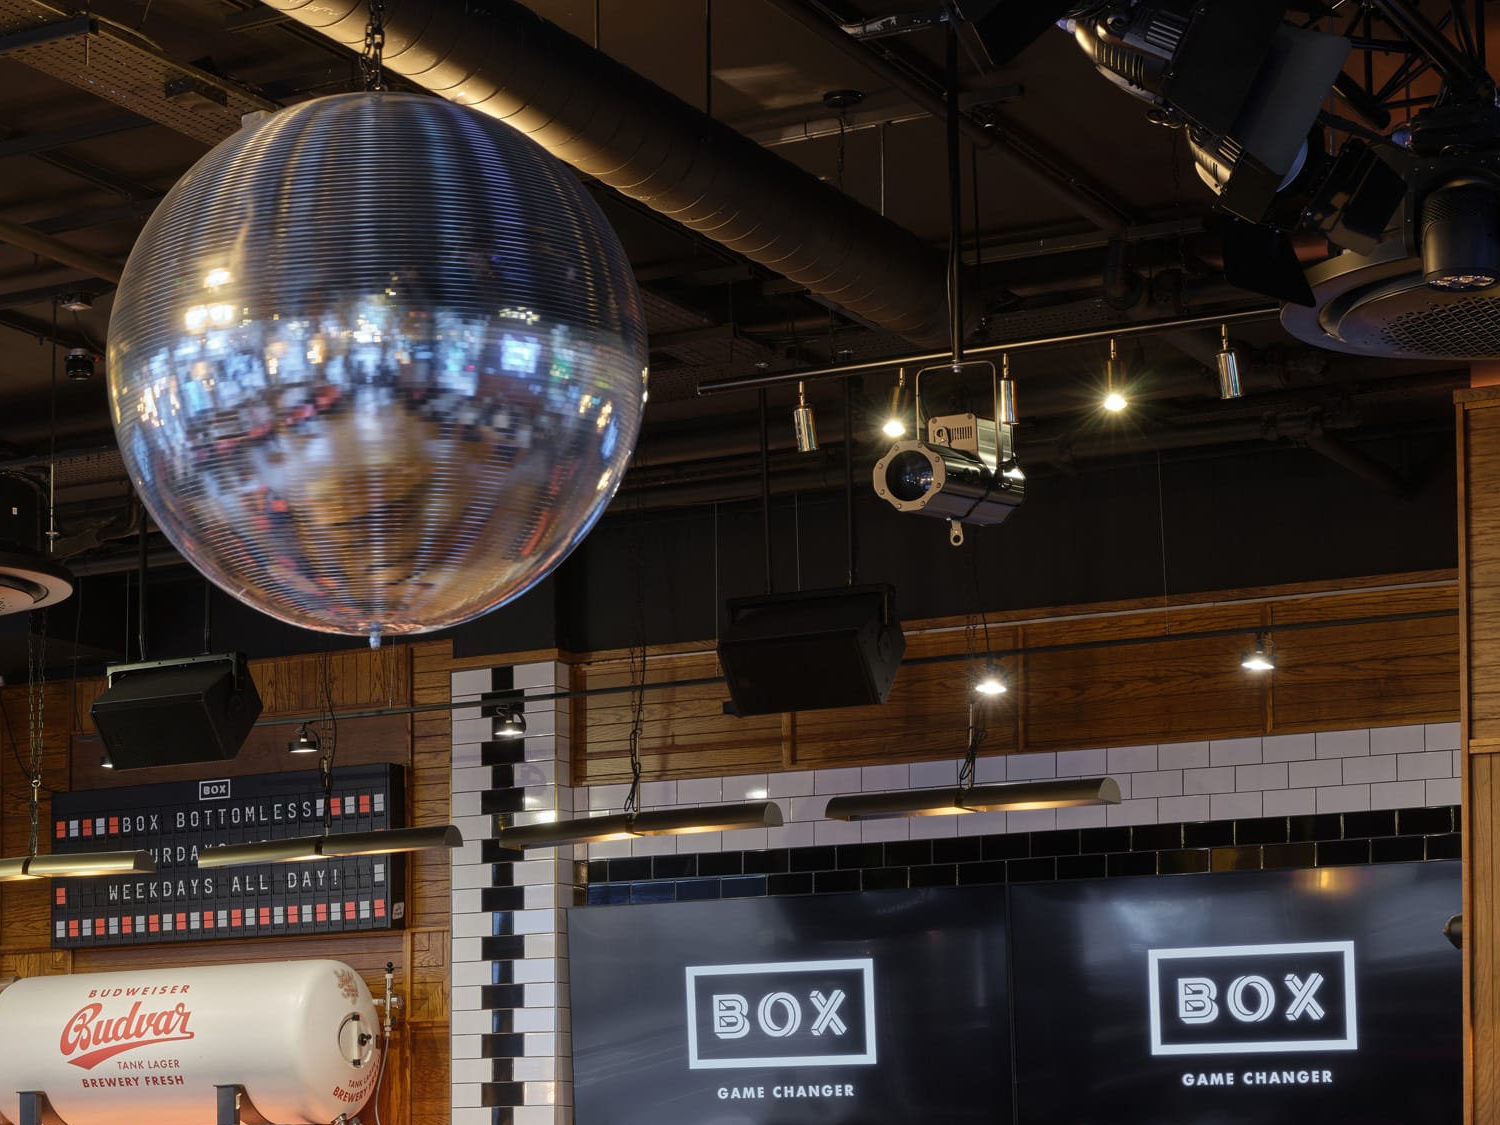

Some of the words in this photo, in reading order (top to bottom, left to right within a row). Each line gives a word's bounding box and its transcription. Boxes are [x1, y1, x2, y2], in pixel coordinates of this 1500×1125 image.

[203, 784, 226, 795] BOX
[122, 814, 158, 832] BOX
[176, 801, 311, 828] BOTTOMLESS
[109, 878, 213, 900] WEEKDAYS
[232, 874, 268, 892] ALL
[288, 869, 337, 889] DAY!
[88, 984, 190, 998] BUDWEISER
[1178, 972, 1325, 1024] BOX
[712, 990, 847, 1040] BOX
[60, 1001, 194, 1070] Budvar
[117, 1061, 145, 1070] TANK
[148, 1059, 180, 1069] LAGER
[82, 1077, 139, 1088] BREWERY
[145, 1075, 184, 1086] FRESH
[1182, 1073, 1234, 1086] GAME
[1243, 1070, 1333, 1084] CHANGER
[717, 1087, 765, 1099] GAME
[773, 1084, 855, 1098] CHANGER
